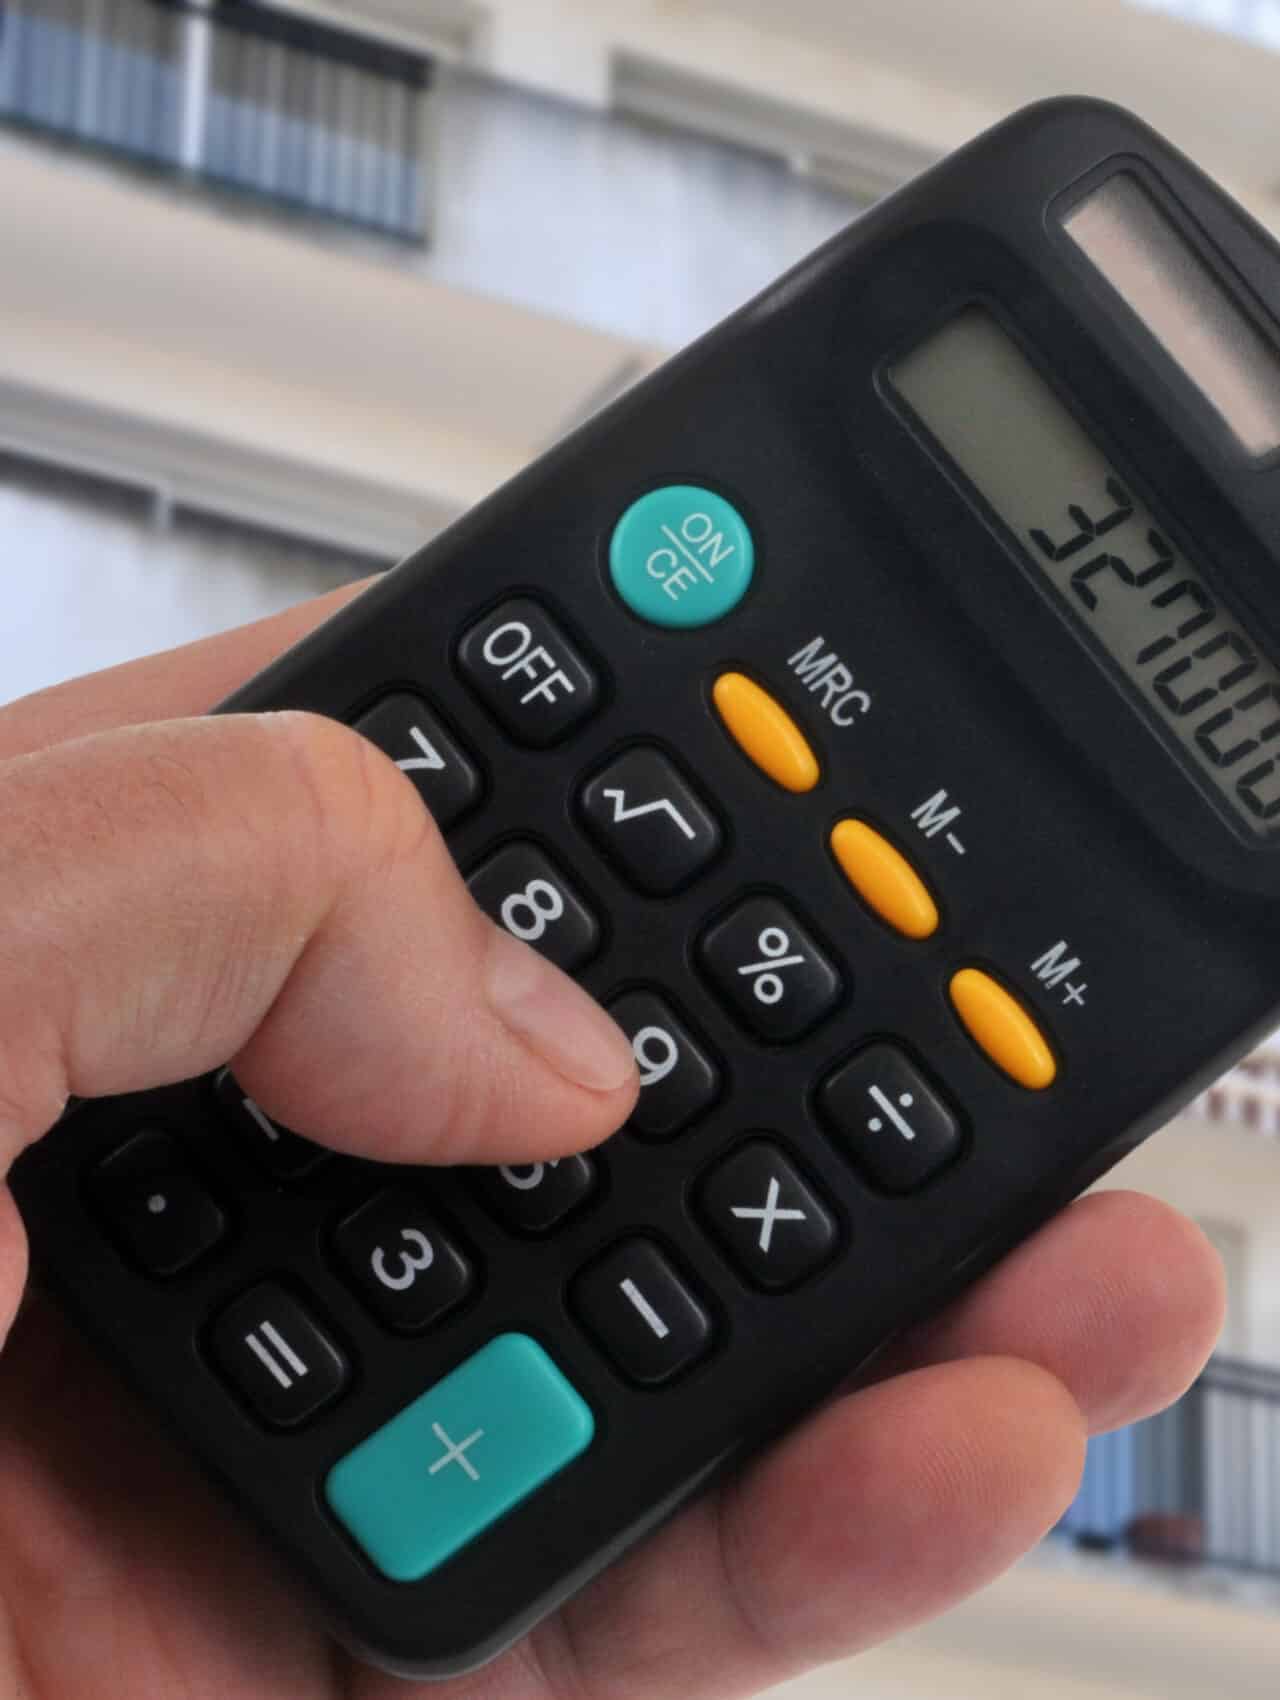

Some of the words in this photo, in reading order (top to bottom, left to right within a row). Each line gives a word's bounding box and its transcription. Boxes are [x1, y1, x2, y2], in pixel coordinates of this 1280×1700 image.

[681, 511, 736, 569] ON
[645, 547, 698, 601] CE
[483, 621, 575, 704] OFF
[787, 636, 870, 726] MRC
[395, 725, 446, 770] 7
[501, 879, 564, 940] 8
[738, 927, 805, 1004] %
[1030, 940, 1087, 1006] M+
[633, 1026, 678, 1086] 9
[371, 1229, 434, 1290] 3
